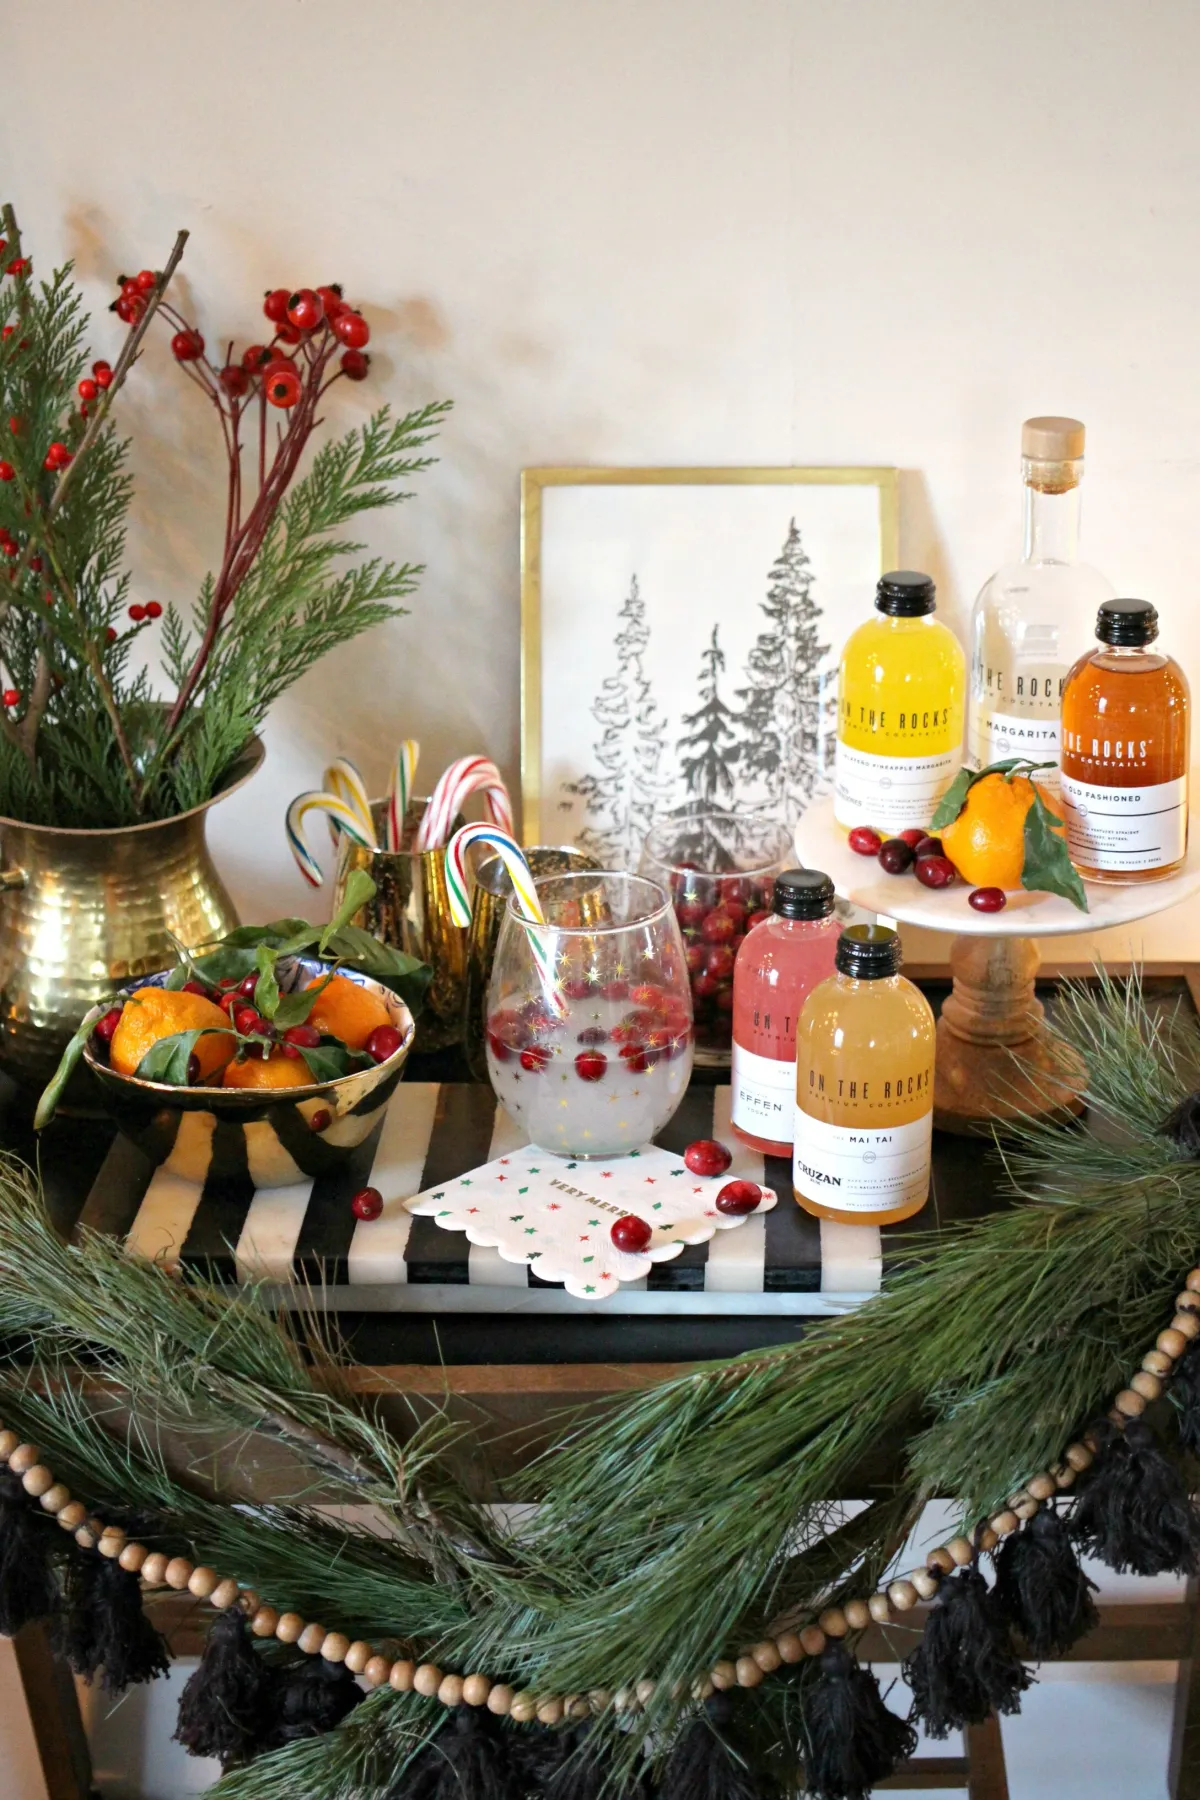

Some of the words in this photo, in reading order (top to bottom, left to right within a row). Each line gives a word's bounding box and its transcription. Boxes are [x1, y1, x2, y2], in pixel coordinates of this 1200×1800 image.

[980, 664, 1003, 691] THE
[1017, 676, 1065, 698] ROCK
[860, 706, 886, 728] THE
[900, 708, 948, 729] ROCKS
[986, 720, 1057, 739] MARGARITA
[1092, 739, 1147, 759] ROCKS
[1080, 756, 1148, 767] COCKTAILS
[1068, 786, 1082, 796] OLD
[1086, 791, 1142, 802] FASHIONED
[754, 1010, 770, 1030] ON
[809, 1069, 825, 1092] ON
[838, 1079, 869, 1099] THE
[884, 1069, 929, 1099] ROCKS
[739, 1090, 782, 1112] EFFEN
[809, 1090, 859, 1108] PREMIUM
[797, 1160, 842, 1187] CRUZAN
[549, 1179, 588, 1198] VERY
[585, 1196, 639, 1218] MERR
